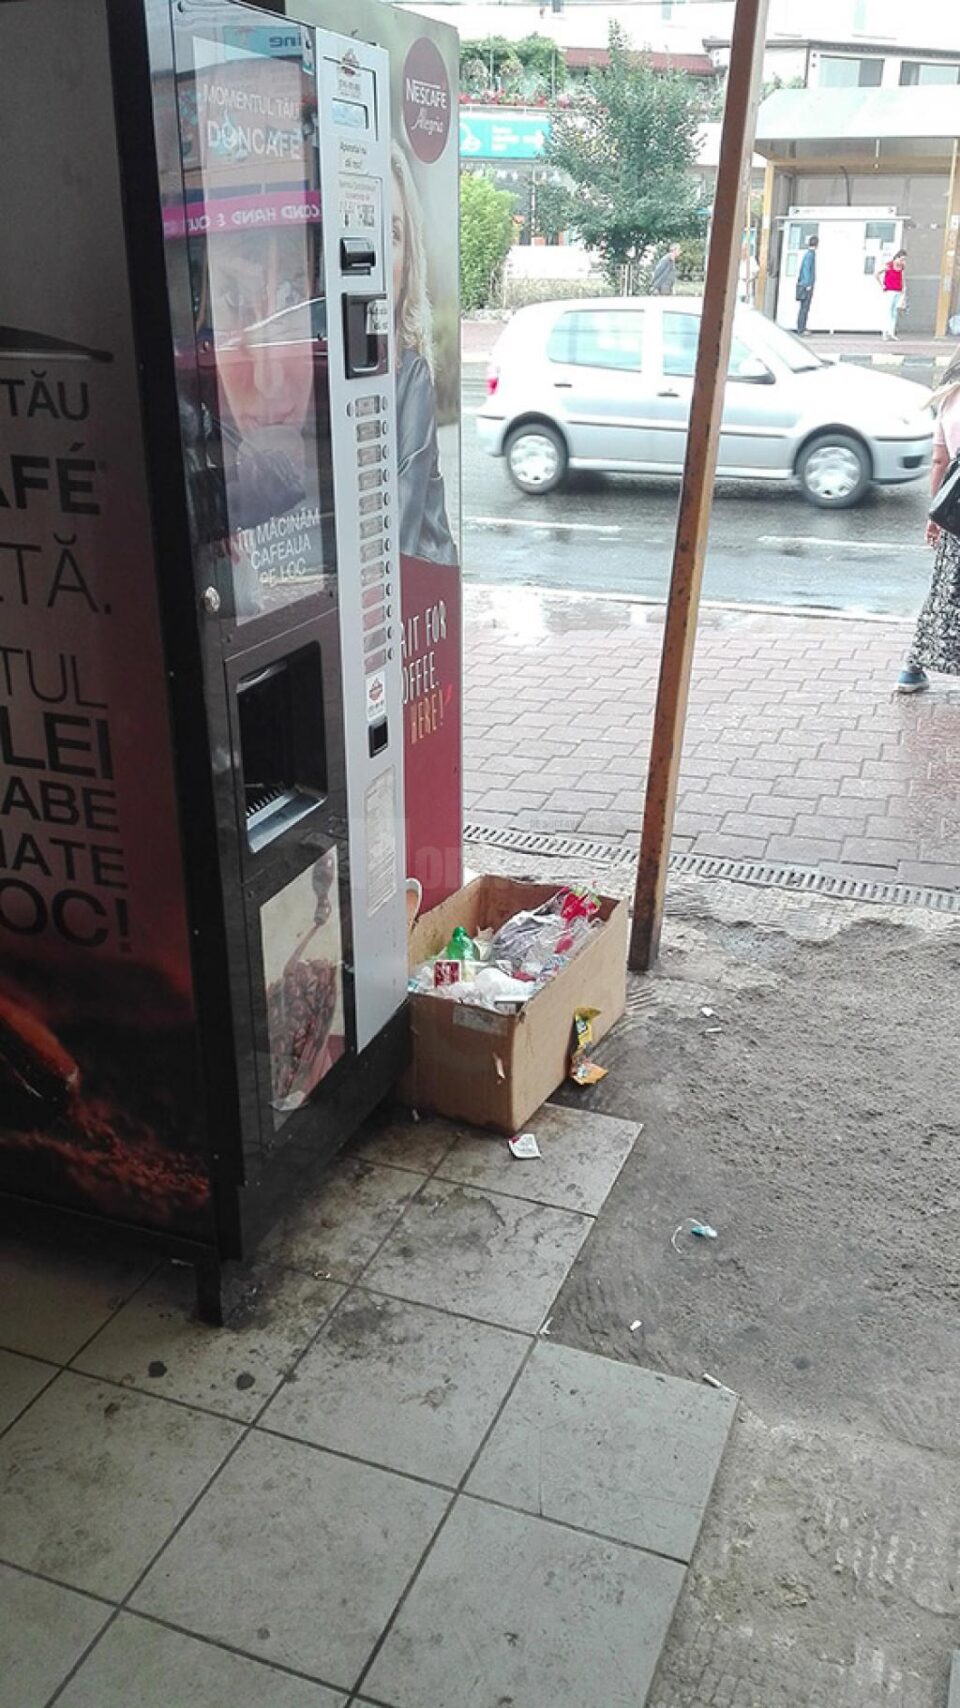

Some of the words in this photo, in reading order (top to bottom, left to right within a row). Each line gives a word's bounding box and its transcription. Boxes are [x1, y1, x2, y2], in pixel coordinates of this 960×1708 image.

[202, 84, 275, 116] MOMENTUL
[0, 369, 90, 420] TĂU
[250, 533, 312, 570] CAFEAUA
[280, 557, 307, 583] LOC
[425, 599, 447, 647] FOR
[0, 646, 108, 709] TUL
